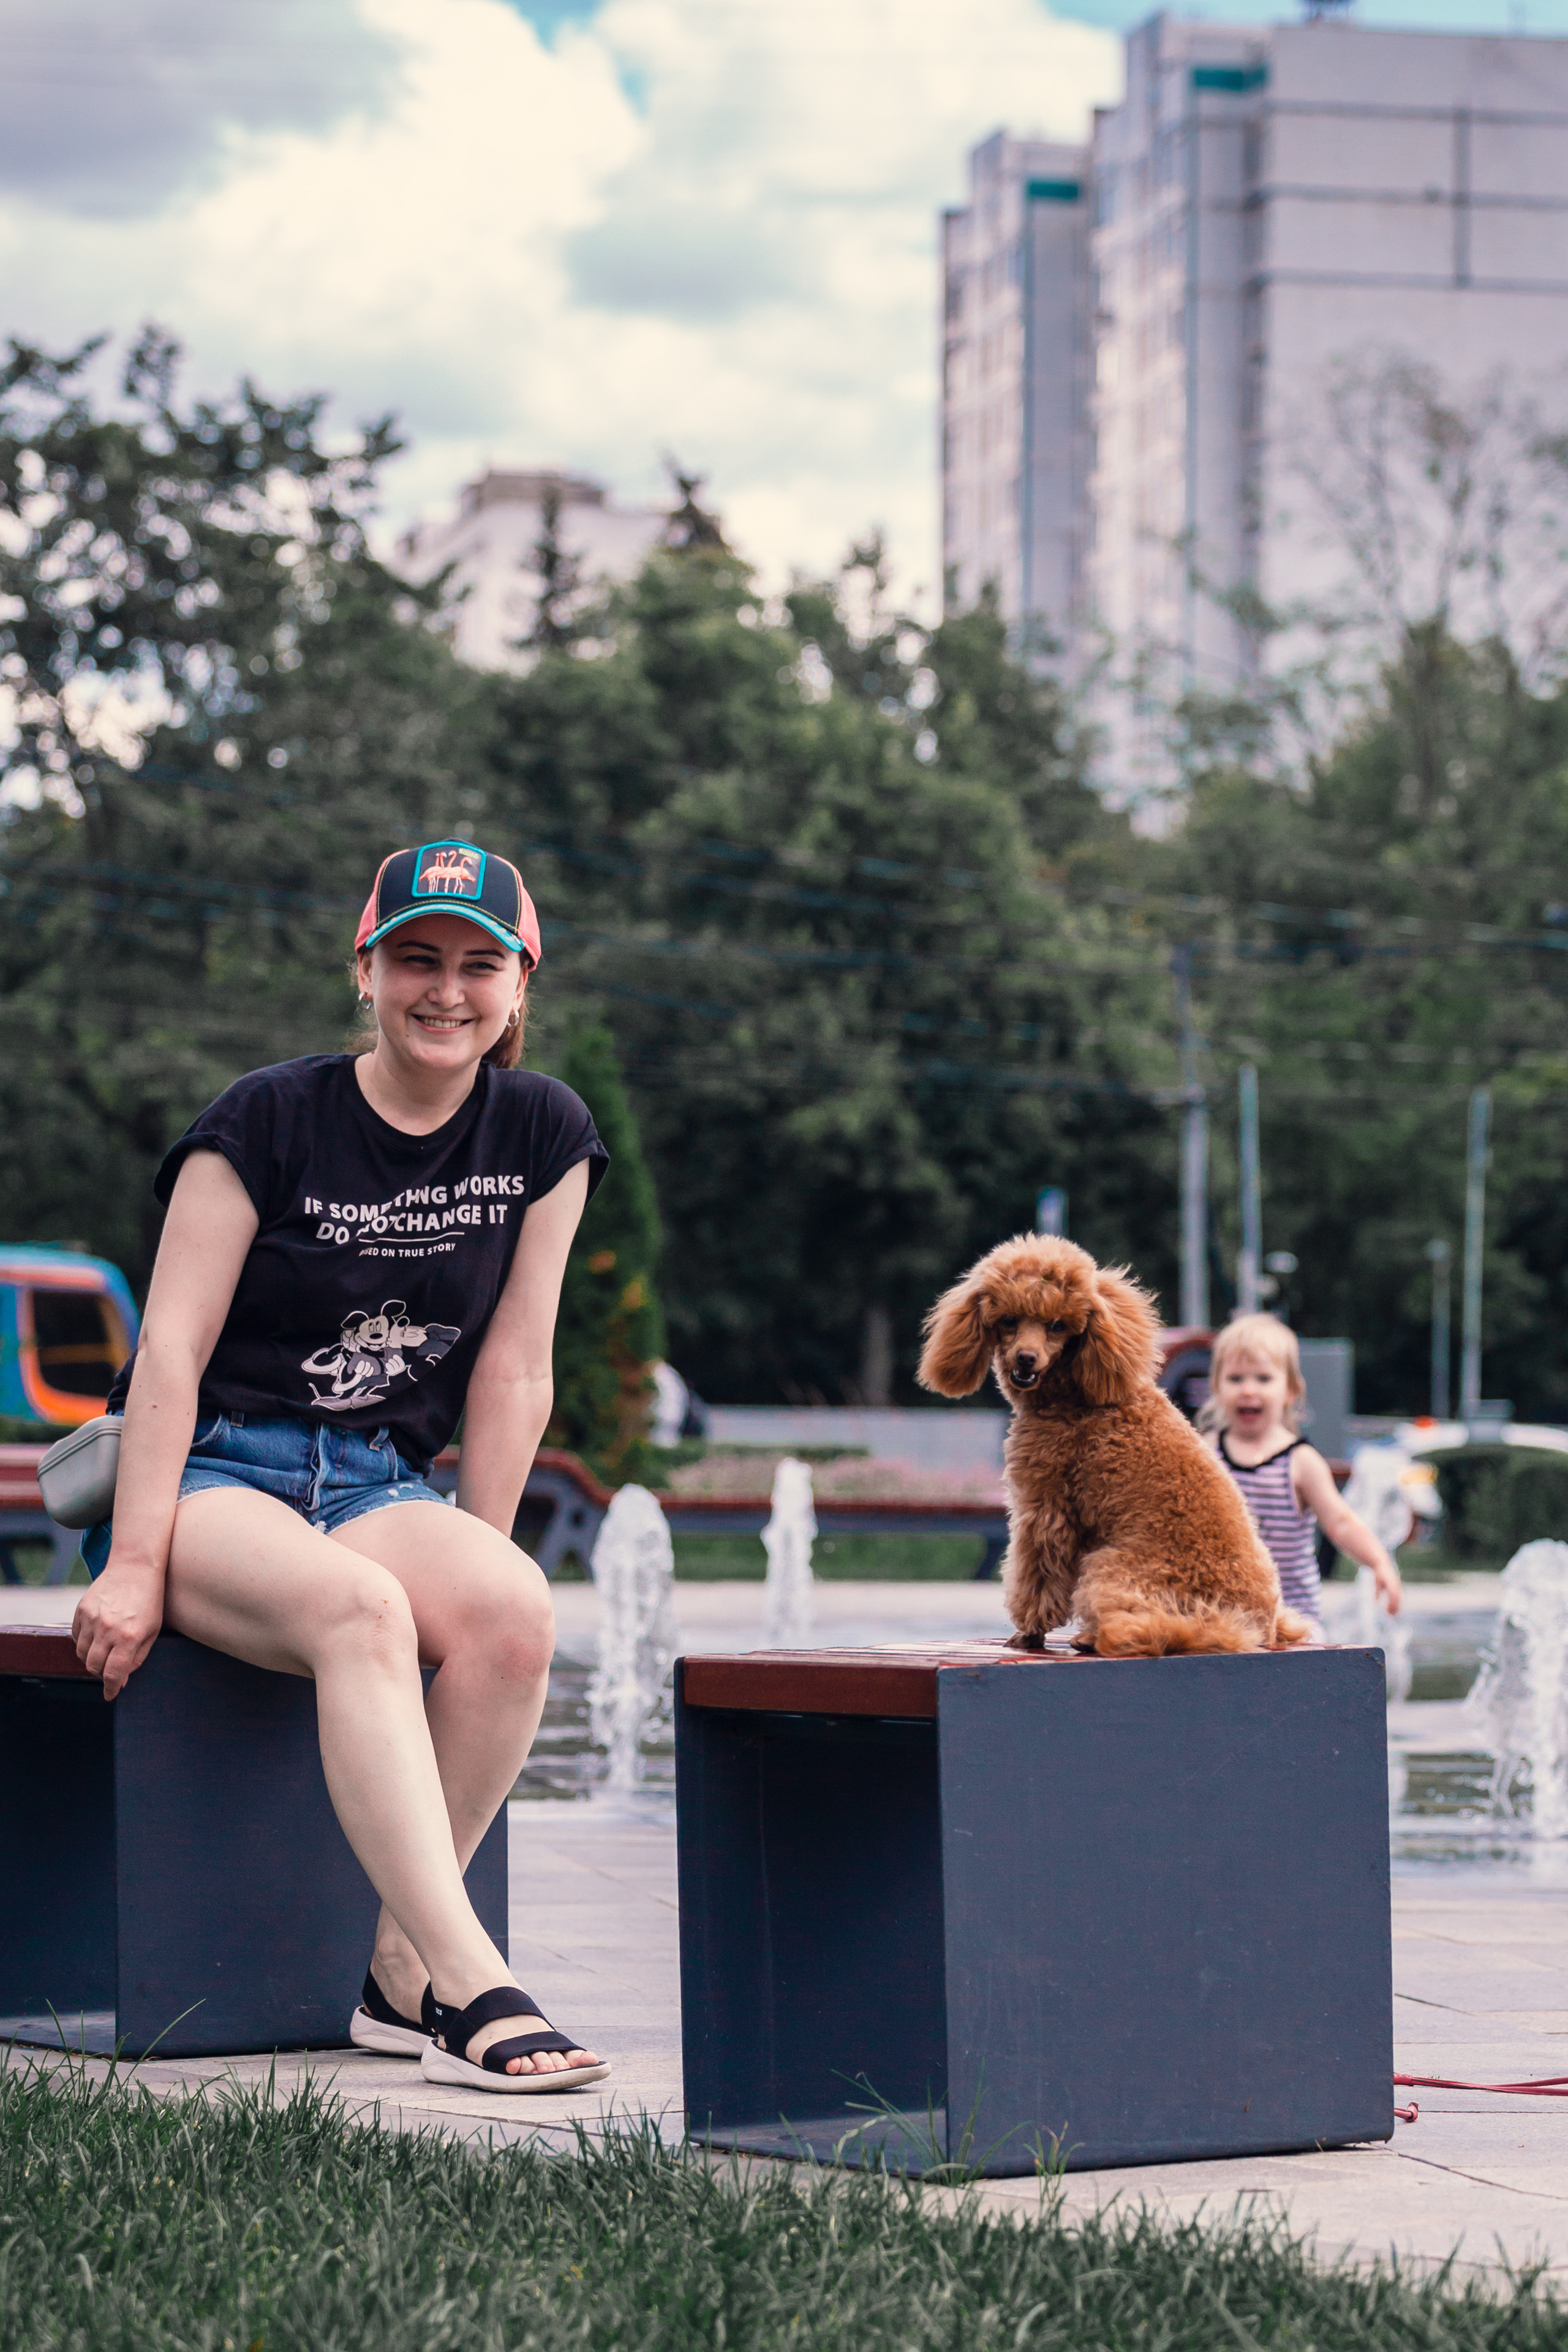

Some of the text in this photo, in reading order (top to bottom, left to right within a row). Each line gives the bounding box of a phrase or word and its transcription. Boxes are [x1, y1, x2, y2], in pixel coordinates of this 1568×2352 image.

[305, 1175, 525, 1223] IF SOMETHNG WORKS
[316, 1222, 350, 1245] DO
[394, 1204, 481, 1232] CHANGE
[489, 1204, 508, 1224] IT
[381, 1248, 395, 1257] ON
[398, 1248, 424, 1257] TRUE
[427, 1243, 456, 1256] STORY
